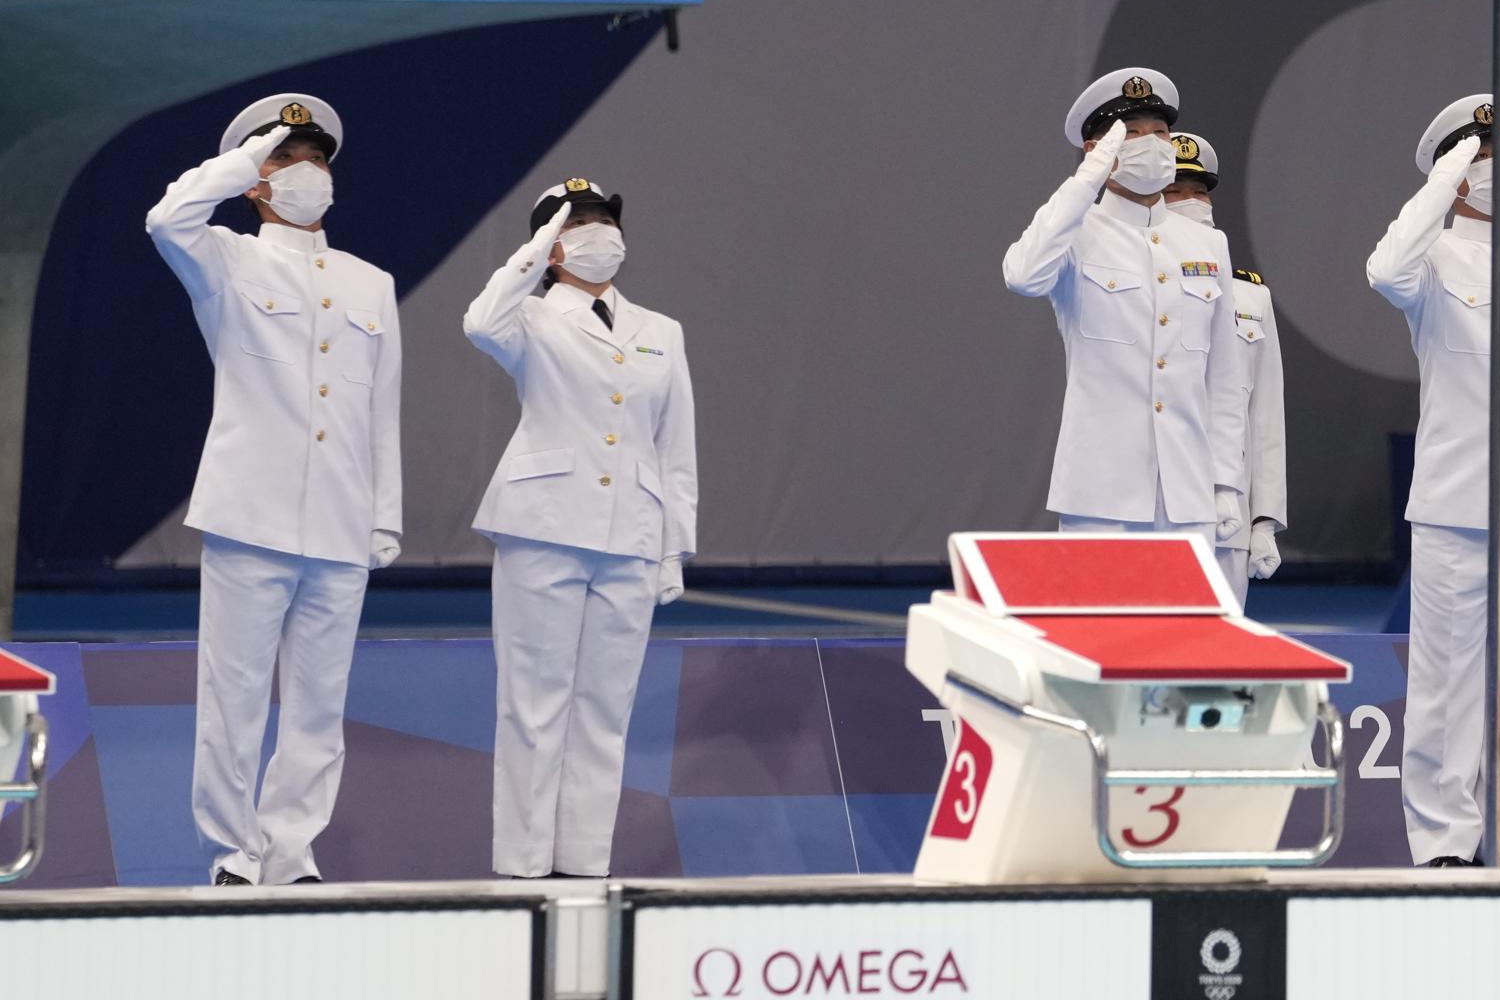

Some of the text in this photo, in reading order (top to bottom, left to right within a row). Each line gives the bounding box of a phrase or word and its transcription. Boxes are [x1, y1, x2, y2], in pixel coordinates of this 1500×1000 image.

[954, 750, 977, 824] 3
[1122, 784, 1186, 848] 3
[762, 949, 968, 996] OMEGA
